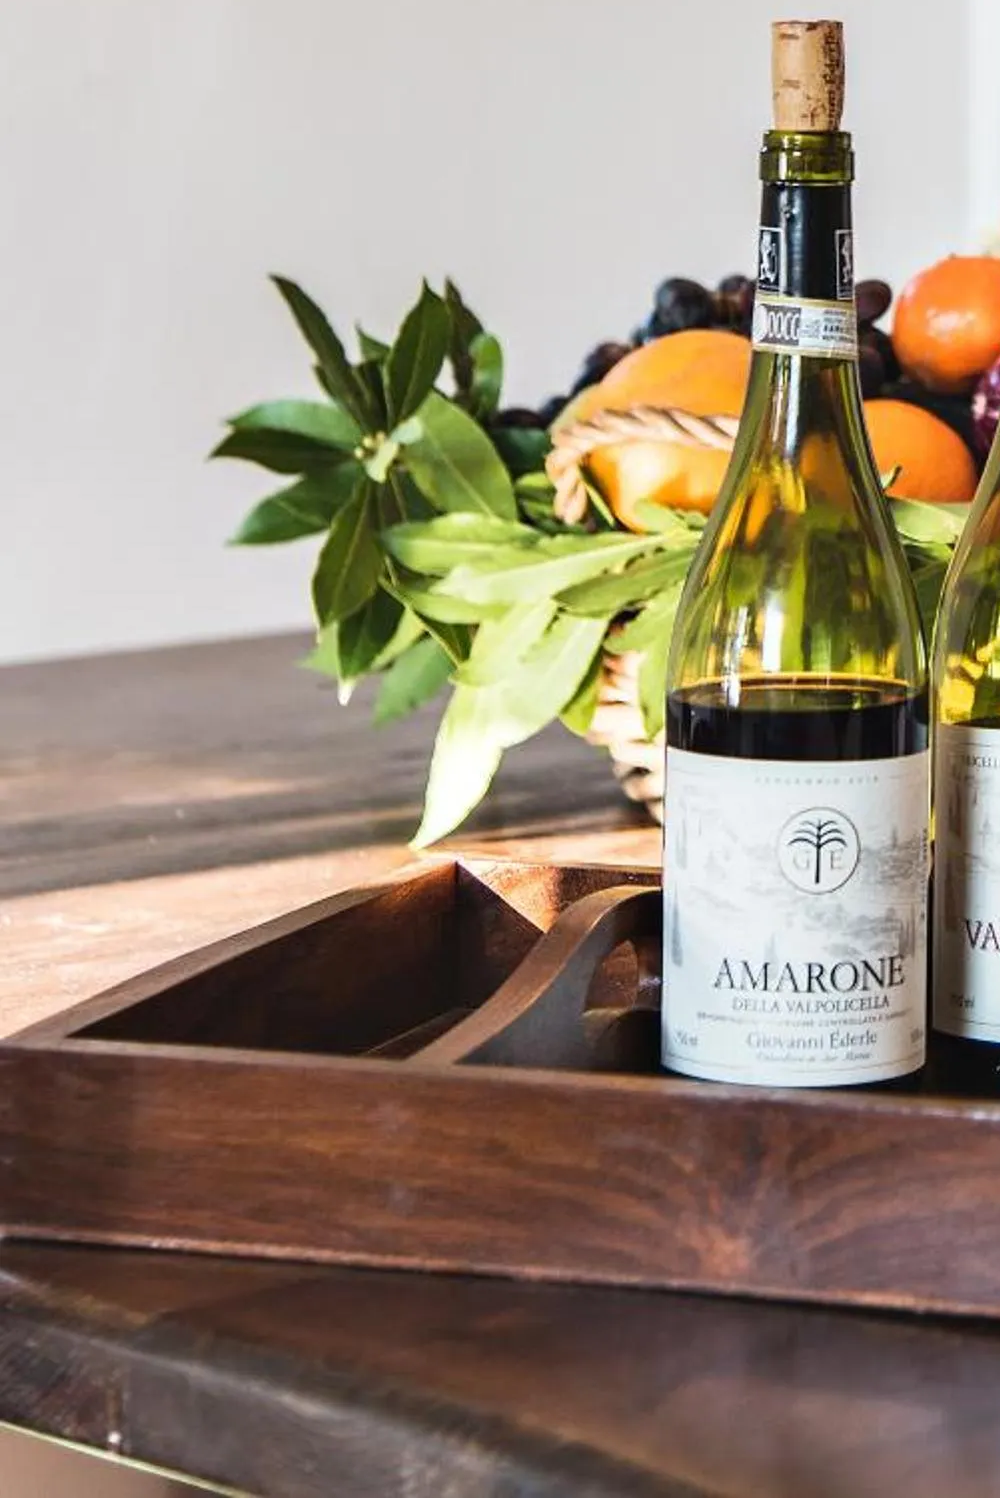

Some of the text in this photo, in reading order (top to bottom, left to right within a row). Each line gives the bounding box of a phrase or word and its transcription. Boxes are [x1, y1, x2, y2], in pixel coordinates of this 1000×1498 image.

[714, 955, 905, 994] AMARONE
[732, 995, 890, 1014] DELLA VALPOLICELLA
[747, 1029, 823, 1050] Giovanni
